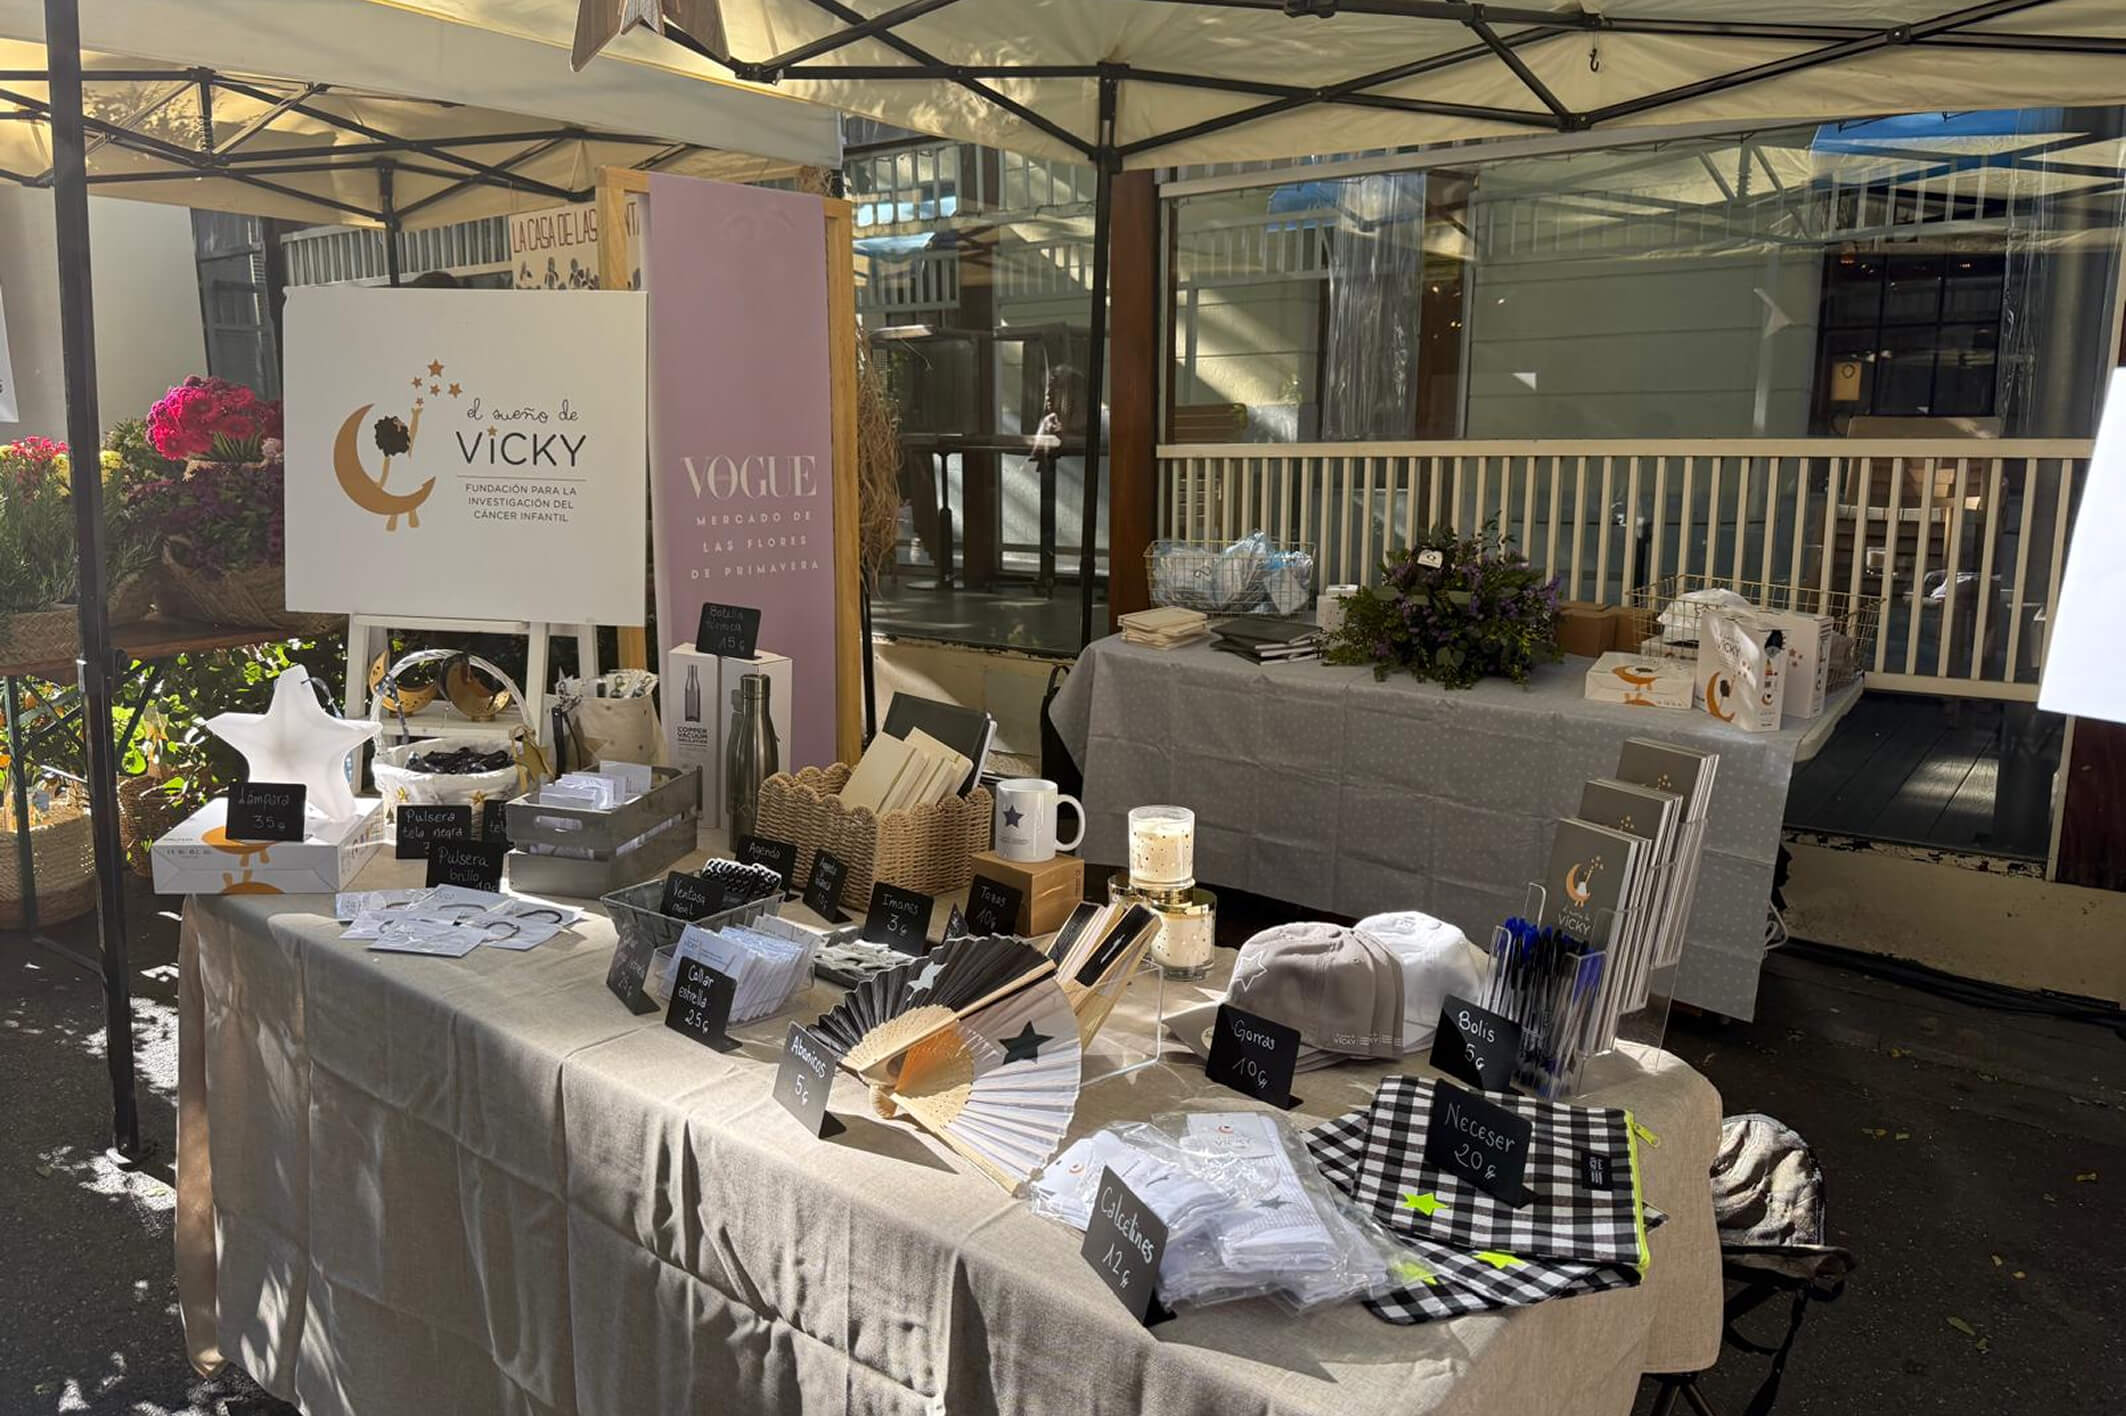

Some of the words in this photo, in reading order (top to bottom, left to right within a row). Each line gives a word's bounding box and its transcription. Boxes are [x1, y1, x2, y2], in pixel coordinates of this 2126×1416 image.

[511, 220, 527, 253] LA
[527, 215, 557, 251] CASA
[557, 212, 574, 247] DE
[574, 208, 598, 244] LAS
[466, 397, 483, 421] el
[492, 407, 548, 424] sueño
[558, 399, 580, 421] de
[681, 455, 817, 499] VOGUE
[465, 483, 528, 494] FUNDACIÓN
[531, 485, 560, 495] PARA
[563, 487, 577, 496] LA
[468, 497, 550, 508] INVESTIGACIÓN
[553, 499, 574, 509] DEL
[474, 509, 517, 520] CÁNCER
[520, 511, 568, 522] INFANTIL
[696, 511, 781, 526] MERCADO
[793, 510, 811, 521] DE
[703, 539, 734, 553] LAS
[746, 535, 807, 549] FLORES
[691, 568, 712, 580] DE
[724, 559, 819, 577] PRIMAVERA
[677, 726, 708, 734] COPPER
[406, 809, 456, 823] Pulsera
[402, 827, 425, 840] tela
[433, 827, 463, 840] negra
[439, 846, 488, 868] Pulsera
[749, 842, 781, 859] Agenda
[449, 867, 480, 882] brillo
[882, 893, 919, 914] Imanes
[980, 886, 1006, 908] Tazas
[688, 964, 714, 989] Collar
[678, 985, 708, 1009] estrella
[1232, 1019, 1275, 1050] Gorras
[1458, 1010, 1495, 1043] Bolis
[791, 1034, 826, 1078] Abanicos
[1100, 1186, 1155, 1264] Calcetines
